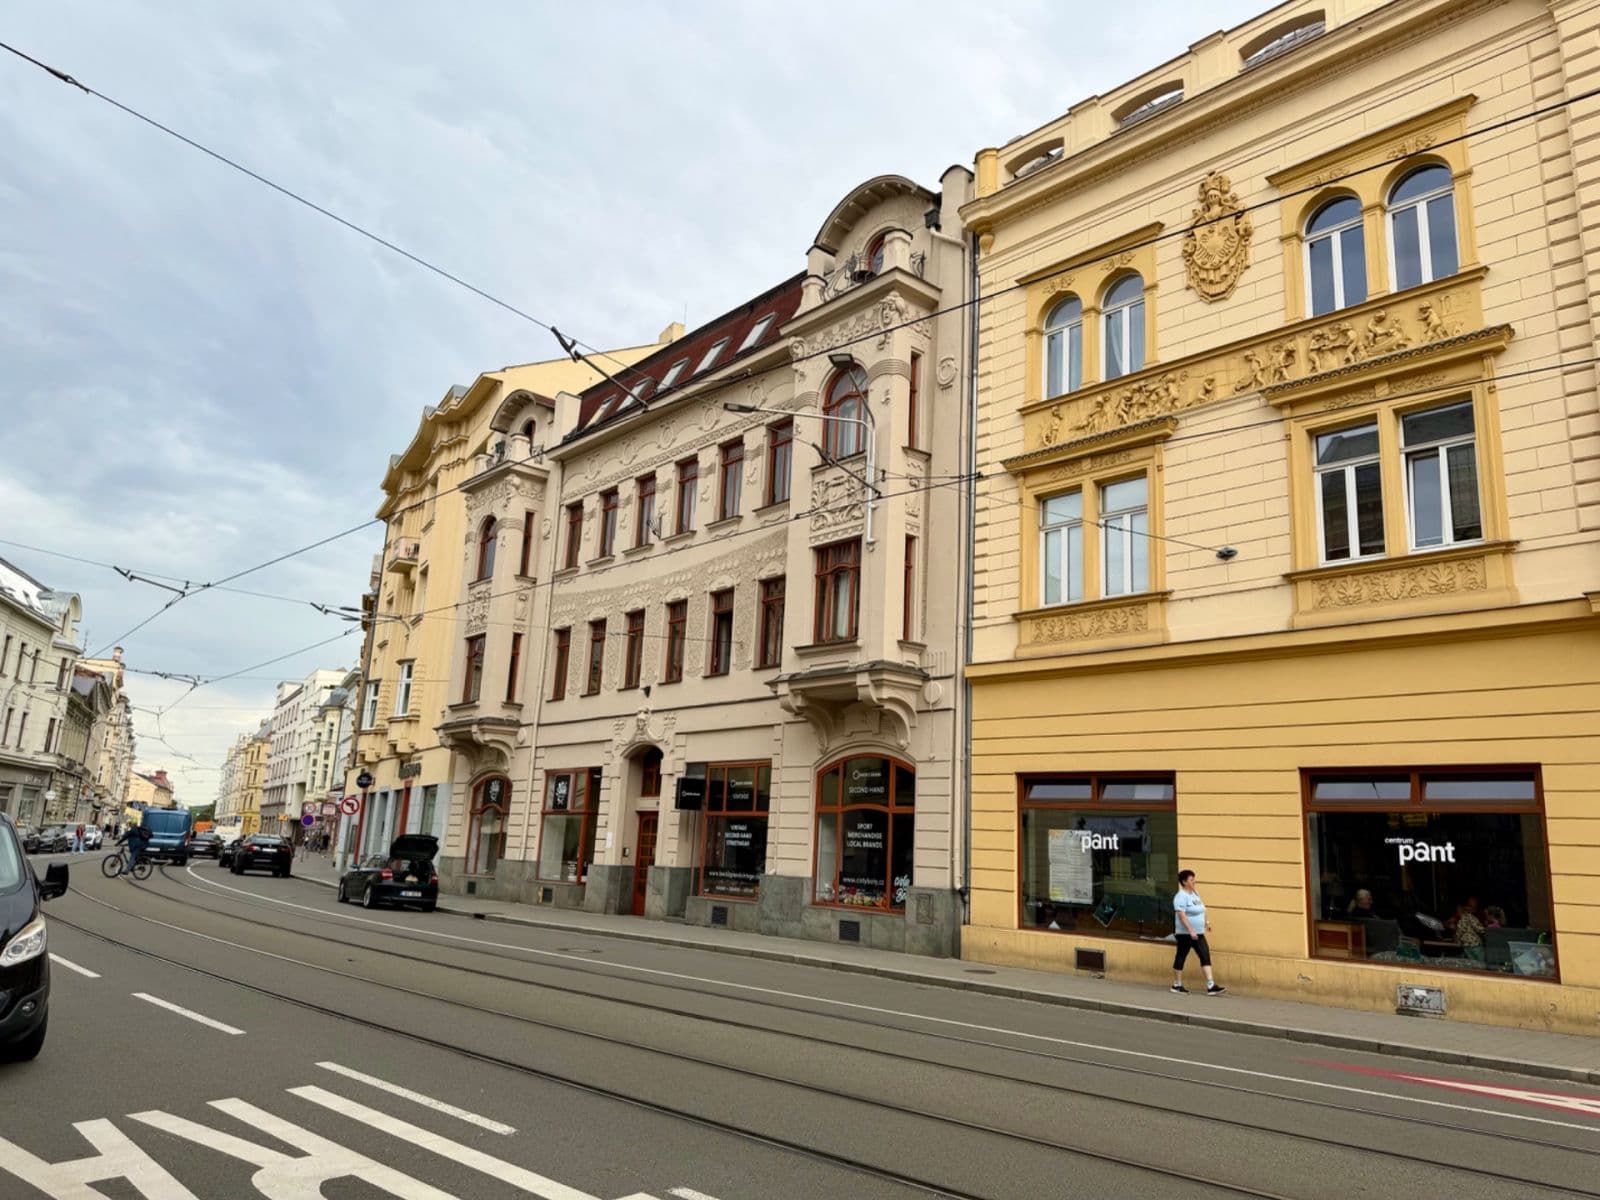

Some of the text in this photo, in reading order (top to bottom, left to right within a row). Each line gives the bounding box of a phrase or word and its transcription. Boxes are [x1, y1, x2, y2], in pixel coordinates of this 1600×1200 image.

[869, 786, 885, 794] HAND
[1081, 833, 1119, 853] pant
[1398, 841, 1456, 866] pant
